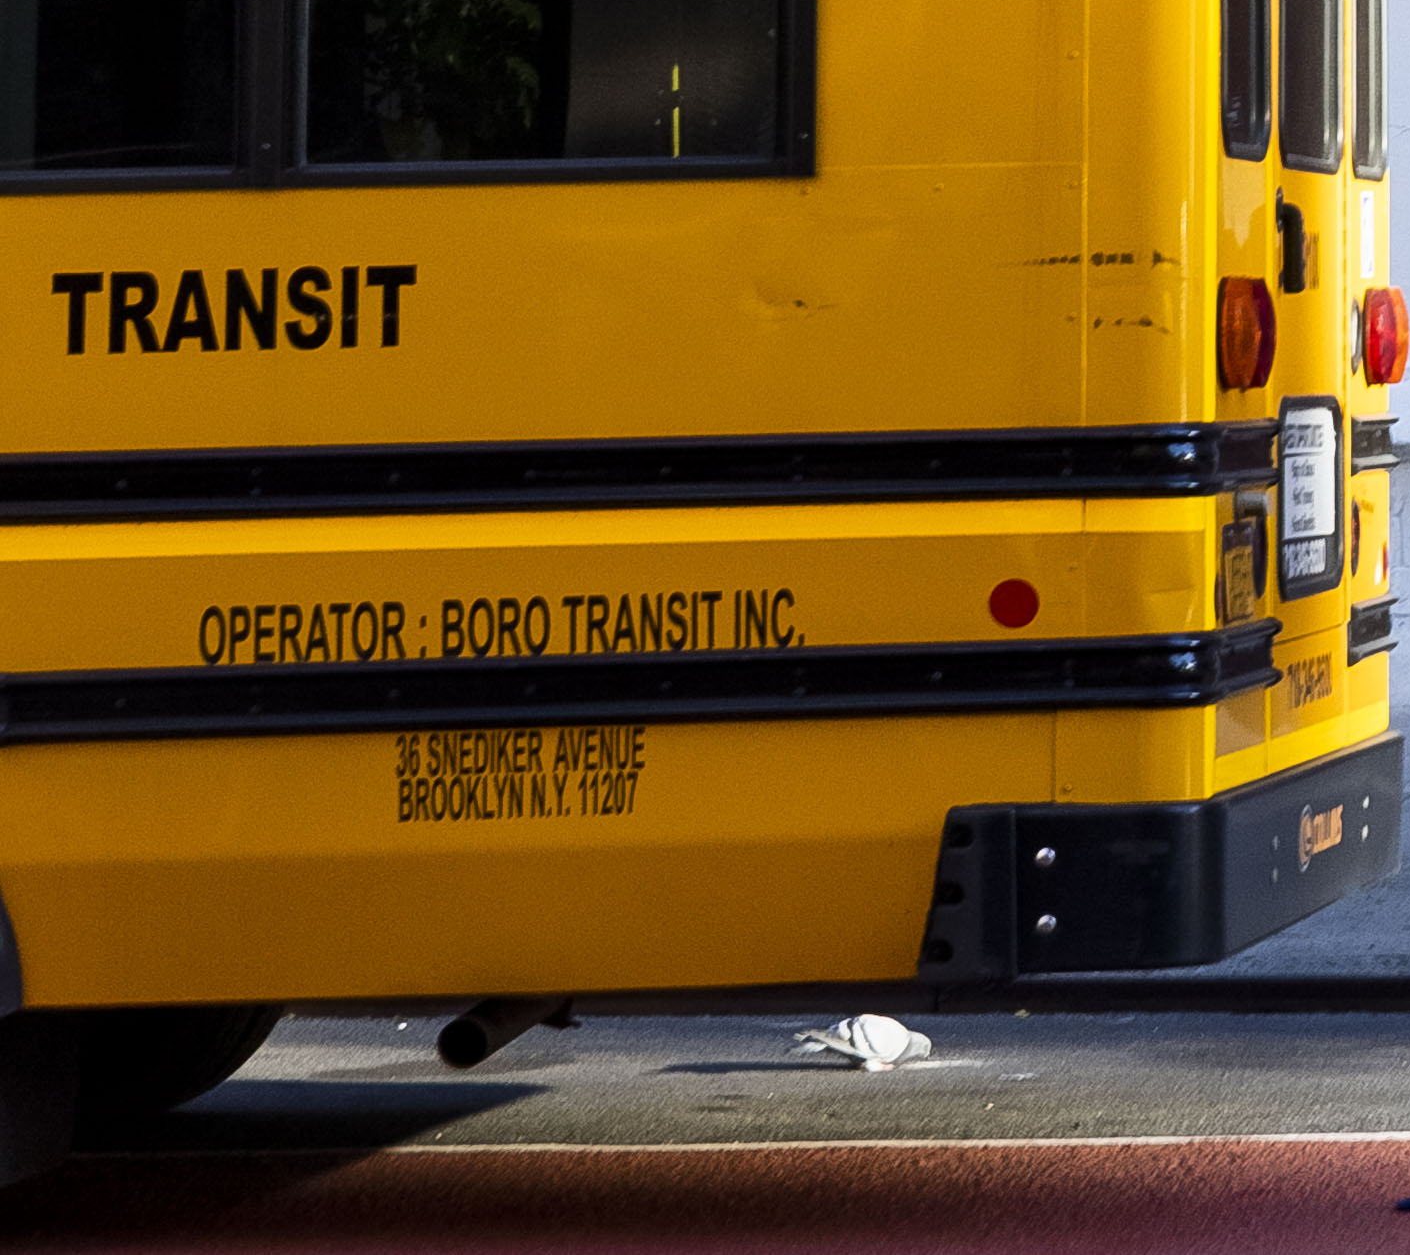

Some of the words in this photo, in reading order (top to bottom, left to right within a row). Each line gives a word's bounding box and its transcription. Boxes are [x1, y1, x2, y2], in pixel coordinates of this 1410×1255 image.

[52, 264, 418, 355] TRANSIT
[200, 601, 407, 666] OPERATOR
[441, 595, 551, 659] BORO
[561, 590, 723, 655] TRANSIT
[734, 587, 806, 650] INC.
[396, 733, 421, 778] 36
[426, 729, 544, 776] SNEDIKER
[552, 726, 646, 773] AVENUE
[397, 774, 525, 823] BROOKLYN
[530, 772, 571, 819] N.Y.
[577, 770, 640, 817] 11207
